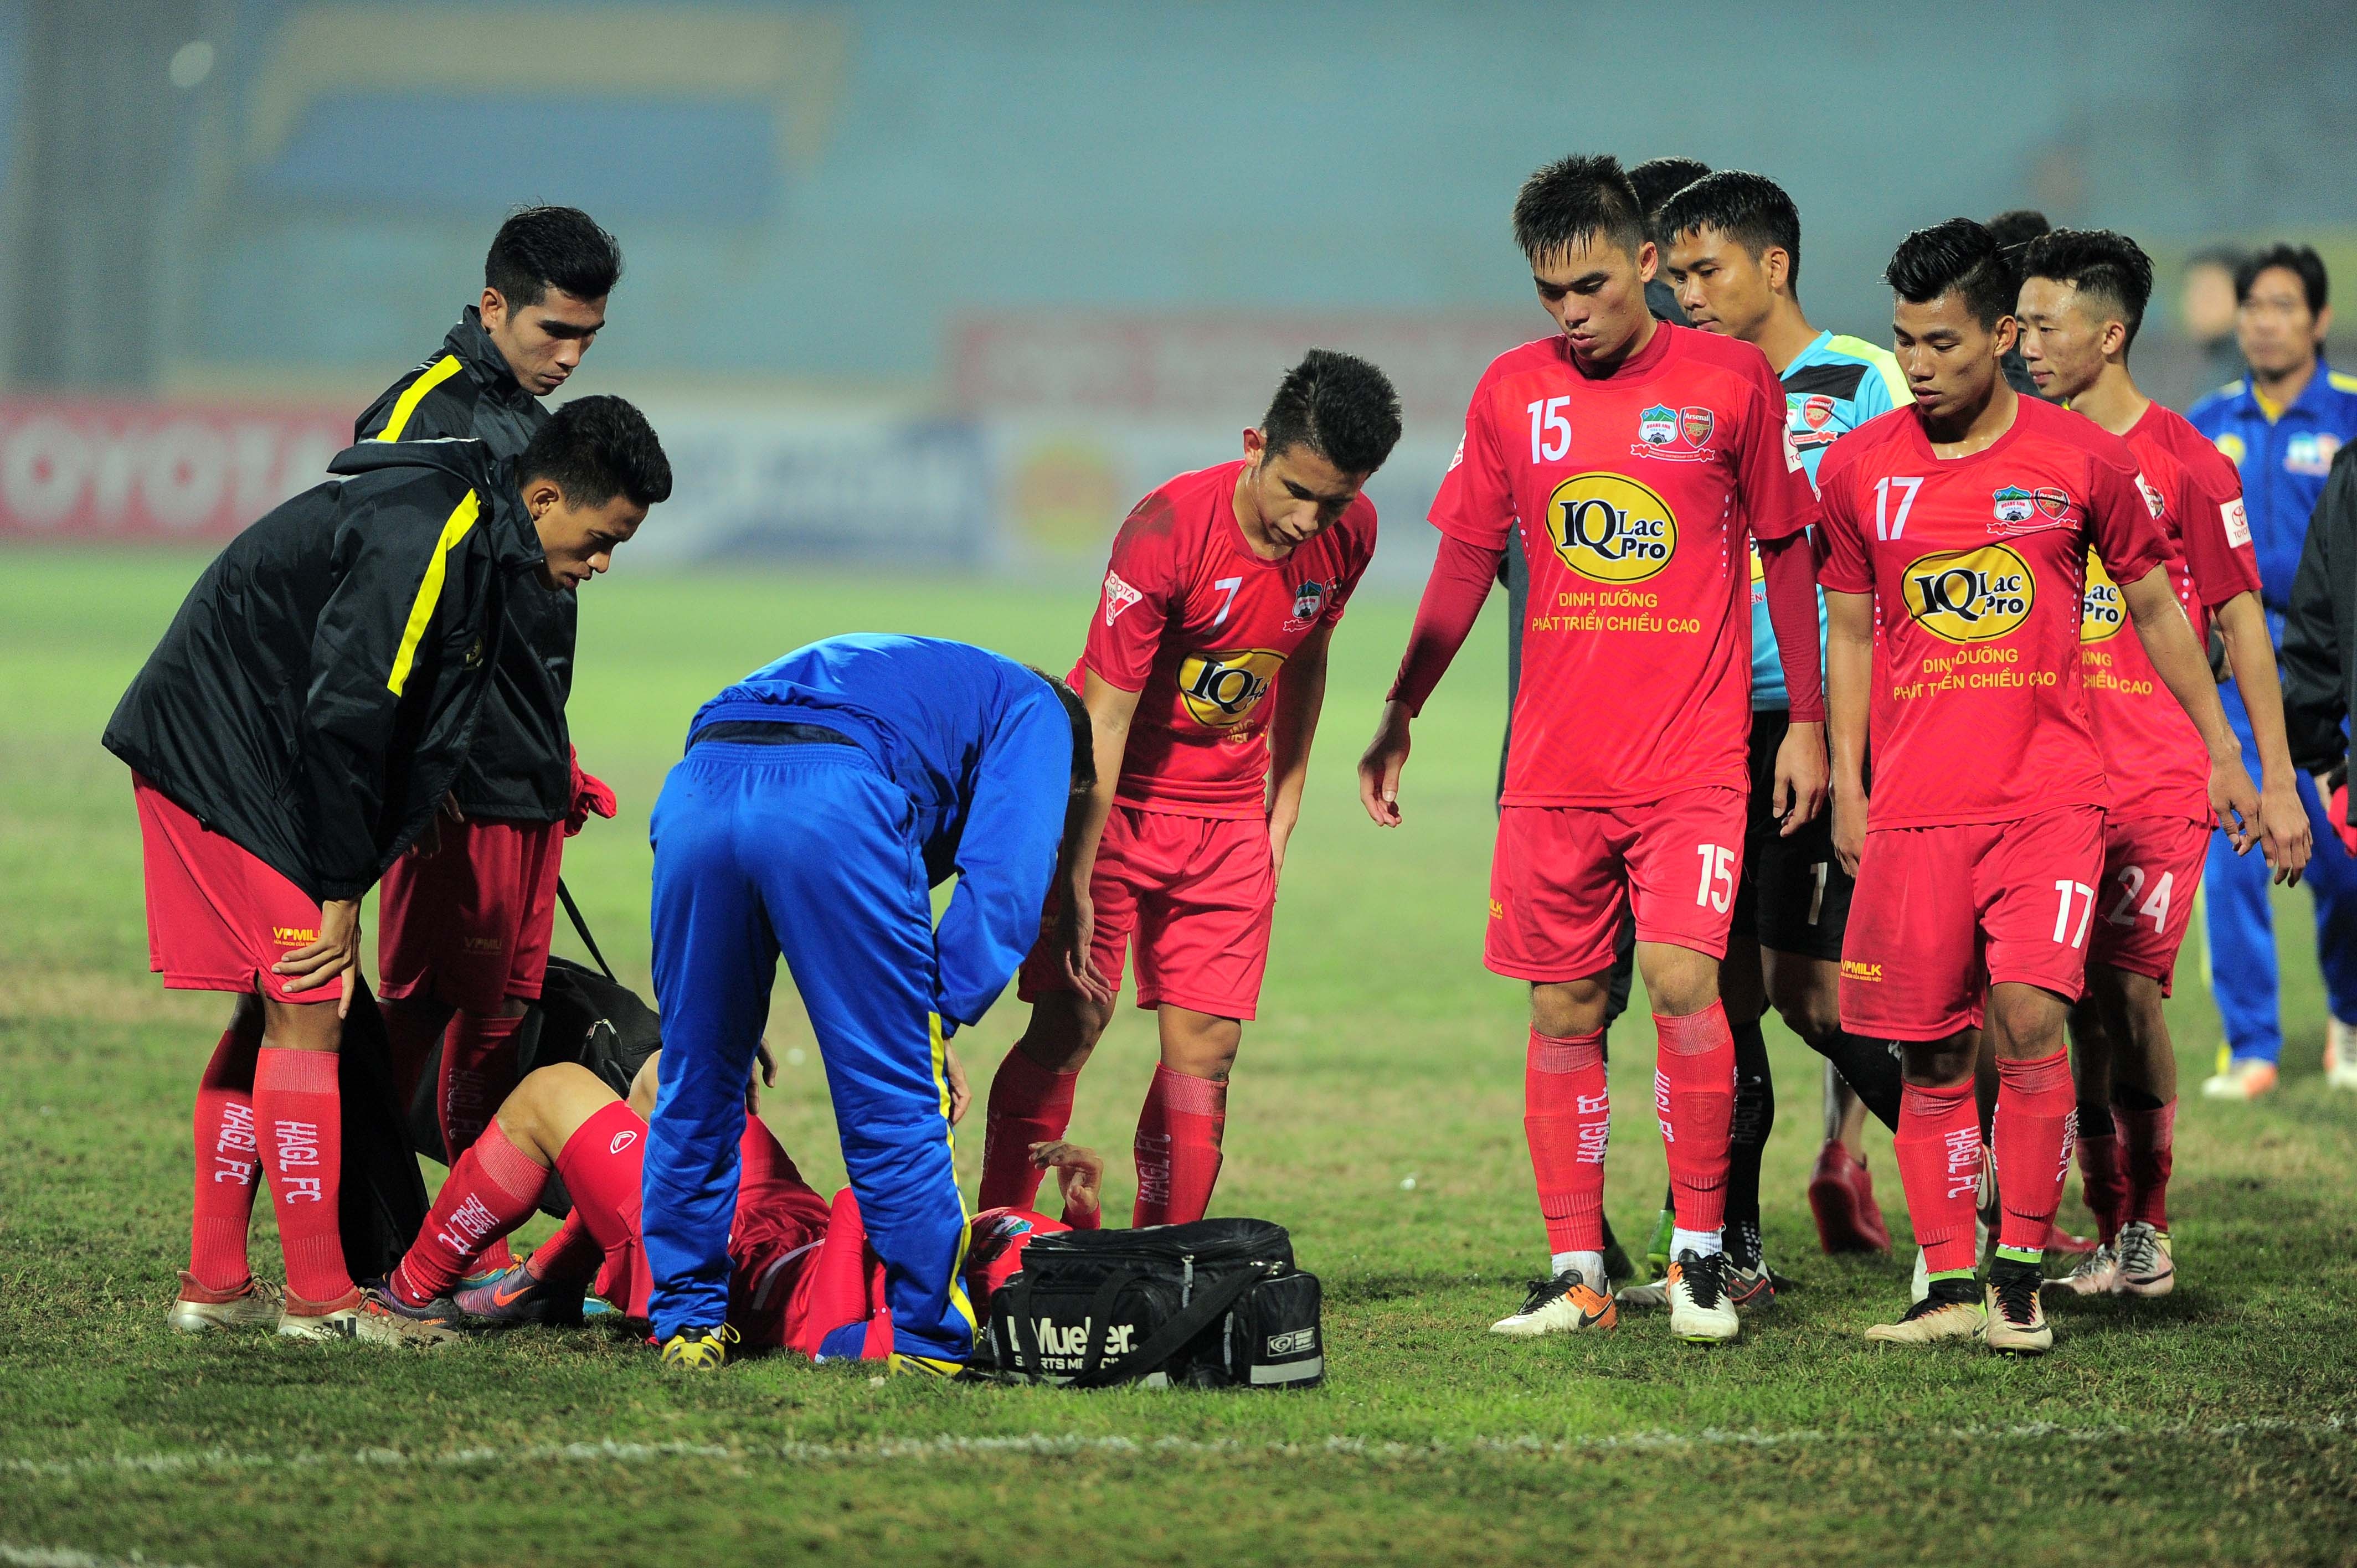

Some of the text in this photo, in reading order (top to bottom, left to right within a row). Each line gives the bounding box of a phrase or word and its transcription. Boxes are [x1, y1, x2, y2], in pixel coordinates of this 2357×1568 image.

[1527, 395, 1572, 465] 15
[1685, 412, 1709, 421] Arsenal
[1873, 476, 1924, 541] 17
[2039, 492, 2064, 501] Arsenal
[1559, 500, 1664, 560] IQ Lac
[1621, 538, 1666, 559] Pro
[1203, 576, 1243, 636] 7
[1559, 589, 1658, 608] DINH DƯỠNG
[1562, 609, 1604, 631] TRIỂN
[1607, 611, 1662, 632] CHIỀU
[1667, 618, 1700, 633] CAO
[1914, 569, 2021, 621] IQ Lac
[1981, 596, 2024, 615] Pro
[1956, 645, 2018, 665] DƯỠNG
[1969, 667, 2024, 688] CHIỀU
[2029, 672, 2056, 686] CAO
[1187, 656, 1254, 714] IQ
[2120, 679, 2153, 695] CAO
[1696, 844, 1735, 914] 15
[1808, 862, 1828, 925] 1
[2109, 865, 2174, 934] 24
[2052, 880, 2094, 949] 17
[1841, 958, 1882, 977] VPMILK
[214, 1102, 257, 1185] HAGL FC
[1576, 1086, 1611, 1164] HAGL FC
[275, 1120, 323, 1204] HAGL FC
[1136, 1159, 1170, 1206] HAGL
[1944, 1125, 1983, 1199] HAGL FC
[438, 1192, 500, 1256] HAGL FC
[420, 1317, 447, 1326] CURIAL
